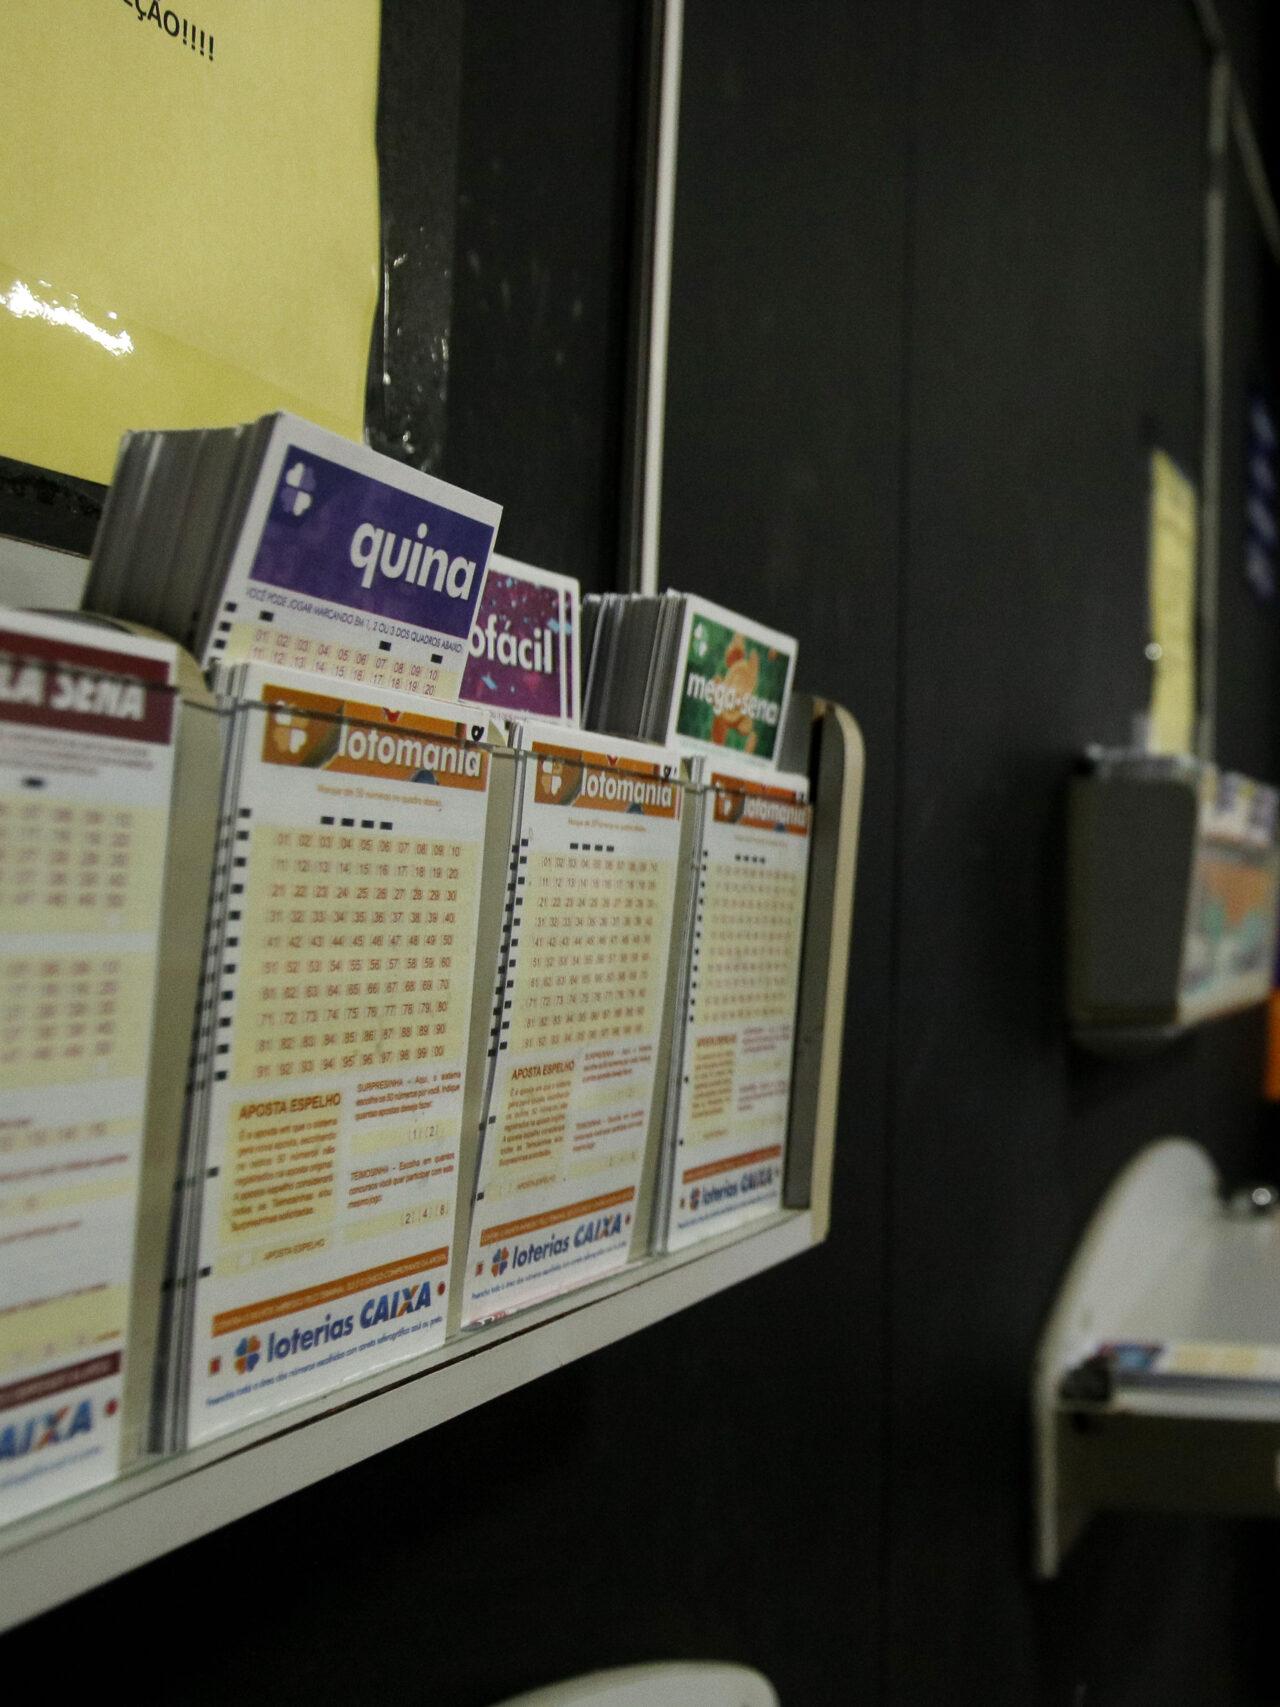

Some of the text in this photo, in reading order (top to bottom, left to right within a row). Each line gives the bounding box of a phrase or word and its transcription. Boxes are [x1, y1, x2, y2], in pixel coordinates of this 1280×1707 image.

[350, 522, 477, 600] quina
[288, 599, 313, 613] JOGAR
[314, 606, 354, 624] MARCANDO
[396, 627, 410, 640] DOS
[410, 632, 440, 648] QUADROS
[687, 671, 778, 725] mega-sena
[338, 724, 482, 777] lotomania
[580, 766, 673, 808] lotomania
[512, 1063, 542, 1080] APOSTA
[239, 1101, 286, 1120] APOSTA
[290, 1092, 341, 1112] ESPELHO
[512, 1234, 570, 1270] loterias
[574, 1213, 621, 1248] CAIXA
[267, 1313, 354, 1362] loterias
[360, 1280, 432, 1329] CAIXA
